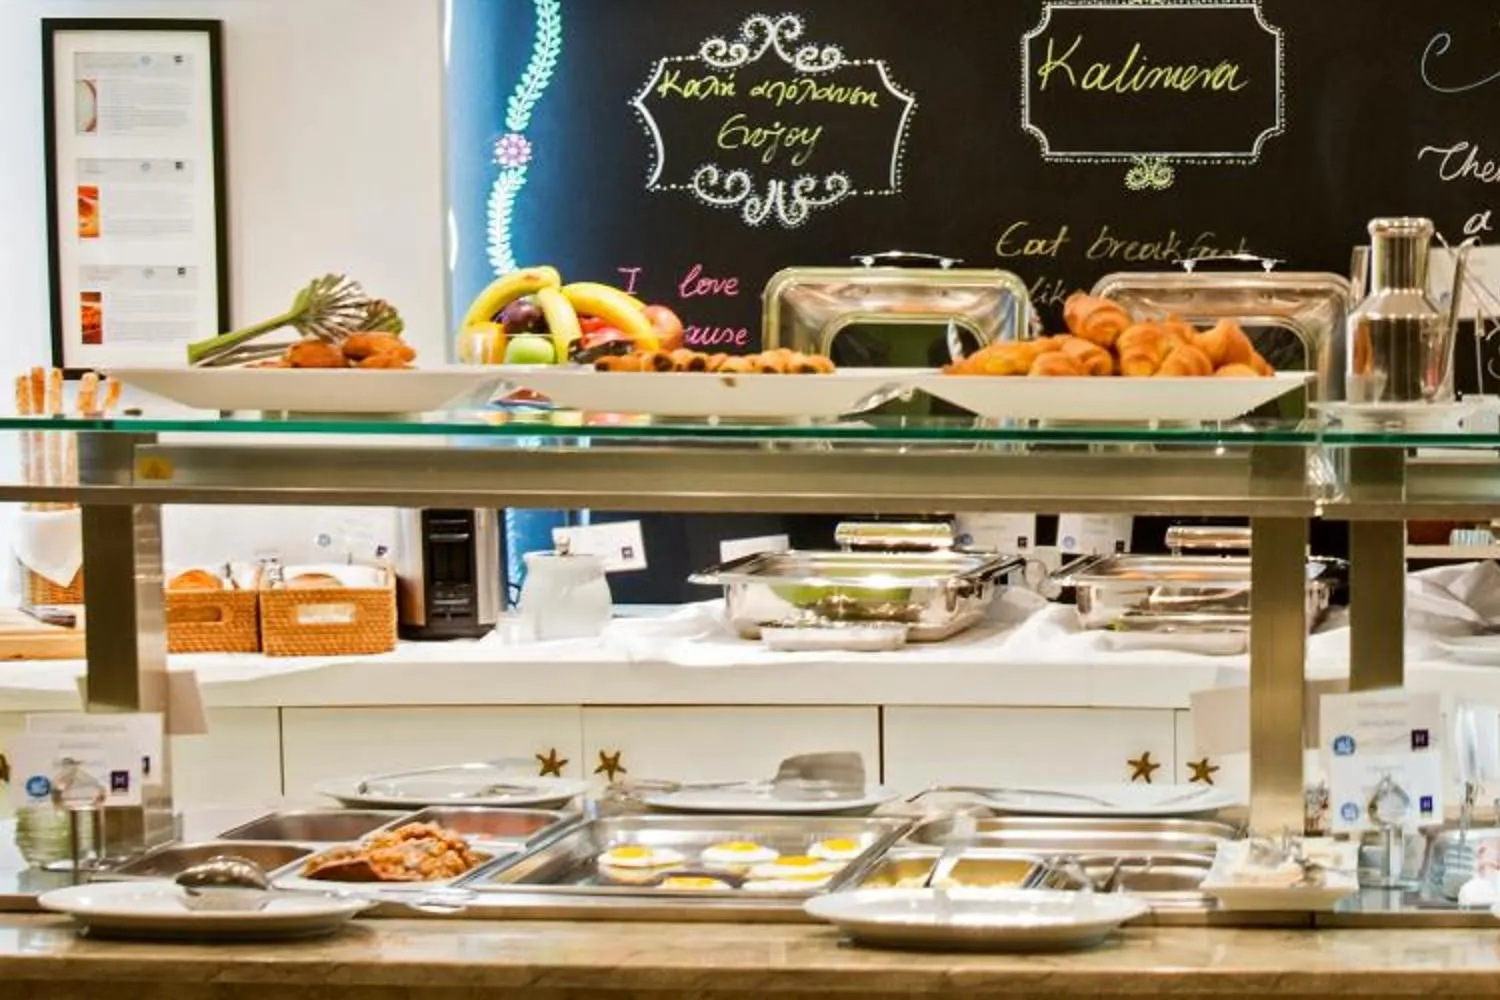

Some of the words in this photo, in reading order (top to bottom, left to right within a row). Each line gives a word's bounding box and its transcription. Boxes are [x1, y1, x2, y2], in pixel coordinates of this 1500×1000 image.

[1039, 36, 1248, 91] Kalimera
[717, 114, 822, 165] Enjoy
[1464, 212, 1492, 233] a
[997, 222, 1071, 258] Eat
[618, 268, 641, 294] I
[681, 264, 739, 297] love
[1030, 277, 1066, 304] lik
[686, 322, 748, 345] ause
